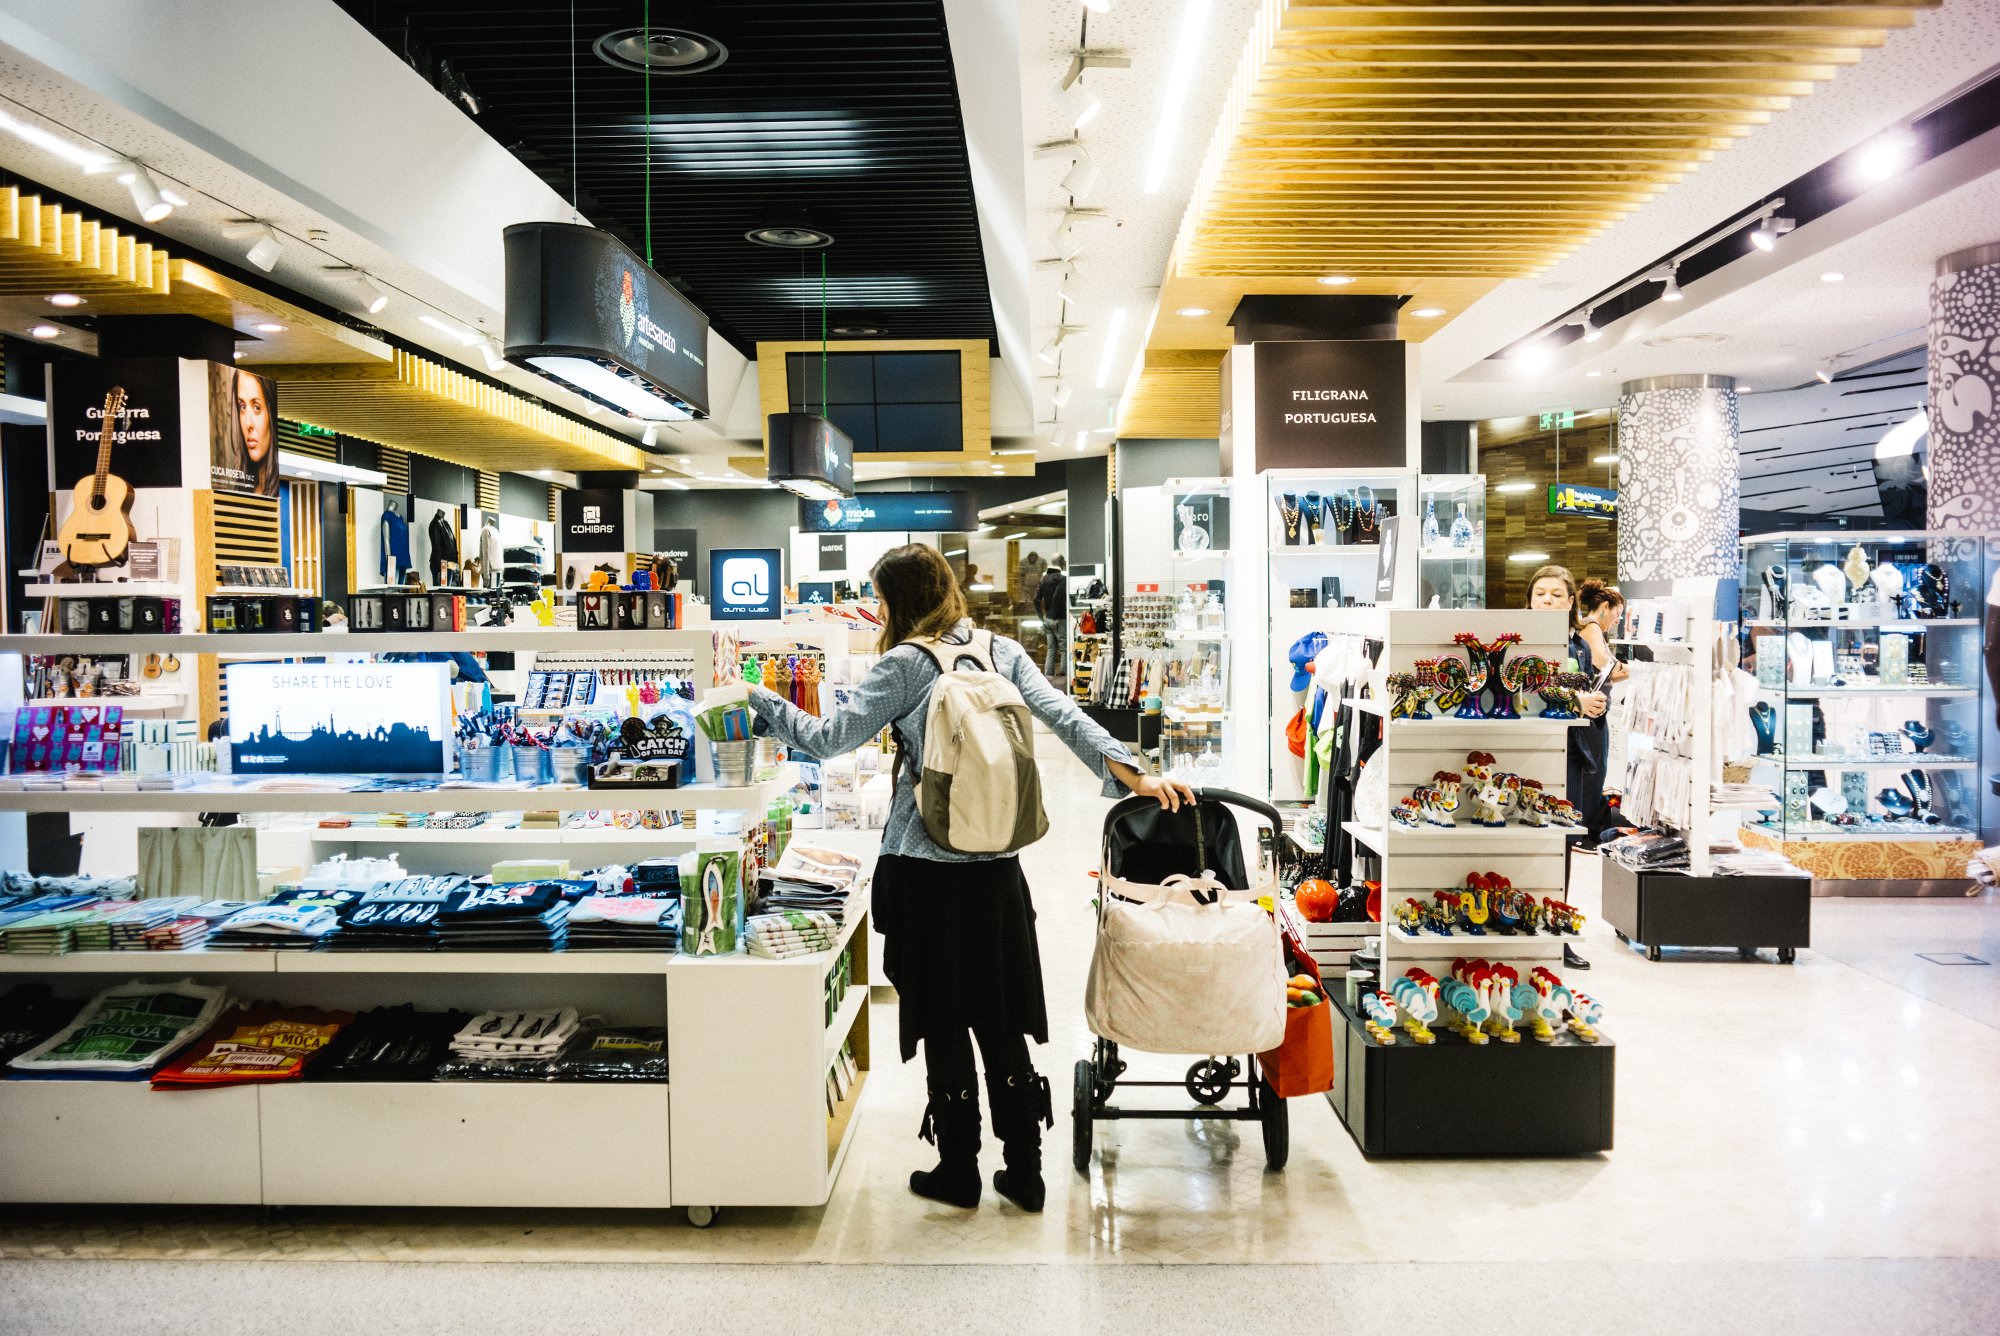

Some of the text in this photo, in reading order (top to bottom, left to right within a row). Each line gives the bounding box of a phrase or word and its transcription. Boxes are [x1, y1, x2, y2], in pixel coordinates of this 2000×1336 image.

[637, 313, 676, 354] artesanato
[1292, 390, 1369, 401] FILIGRANA
[86, 407, 150, 419] Guarra
[1284, 412, 1377, 424] PORTUGUESA
[75, 429, 162, 445] Porguesa
[211, 465, 225, 476] CUCA
[225, 468, 246, 480] ROSETA
[845, 507, 876, 518] moda
[571, 524, 613, 534] COHIBAS
[272, 675, 393, 689] SHARE THE LOVE
[636, 738, 686, 751] CATCH
[640, 749, 651, 757] OF
[652, 748, 667, 756] THE
[668, 749, 684, 757] DAY
[280, 1034, 321, 1049] MOÇA
